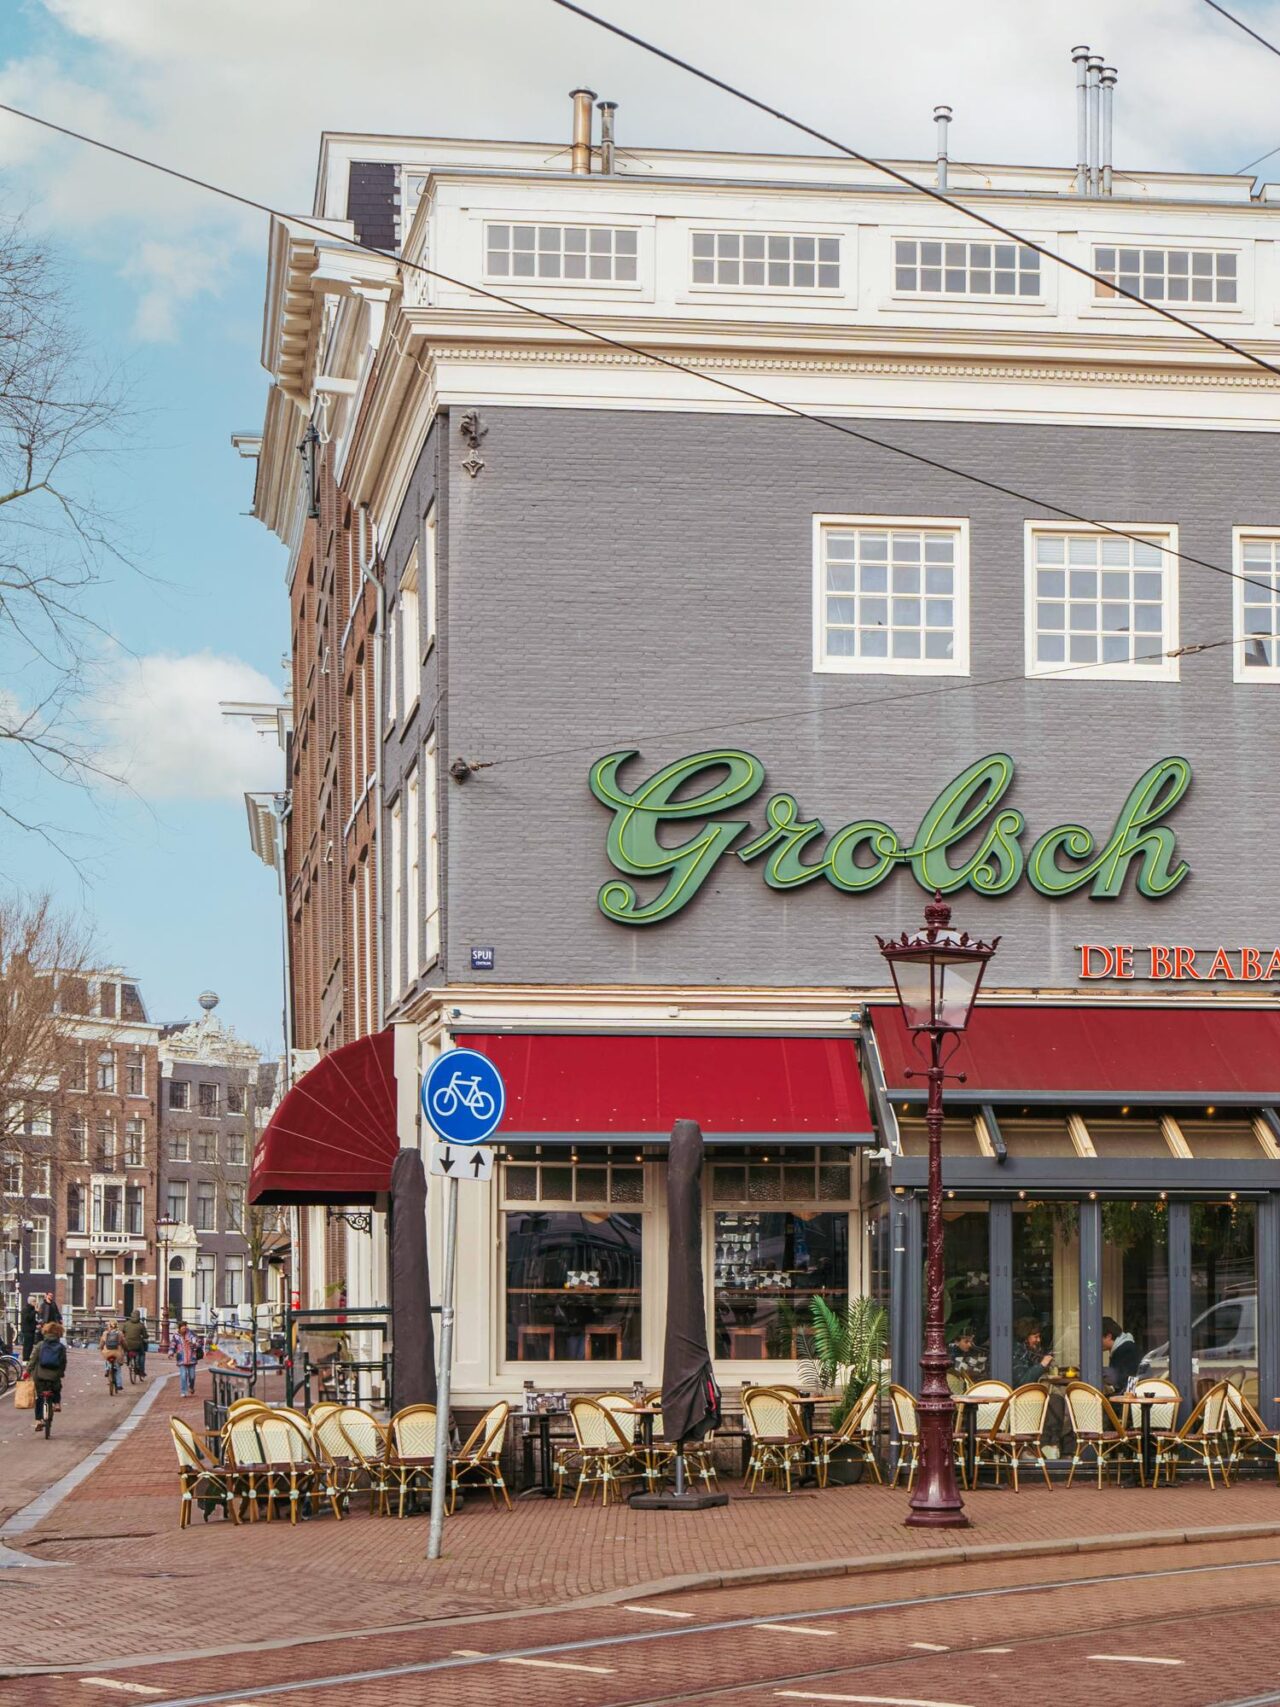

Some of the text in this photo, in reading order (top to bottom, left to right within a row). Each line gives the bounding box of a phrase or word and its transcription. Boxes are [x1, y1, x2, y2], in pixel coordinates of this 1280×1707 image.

[588, 748, 1192, 926] Grolsch
[472, 950, 492, 960] SPUI
[1079, 944, 1135, 980] DE
